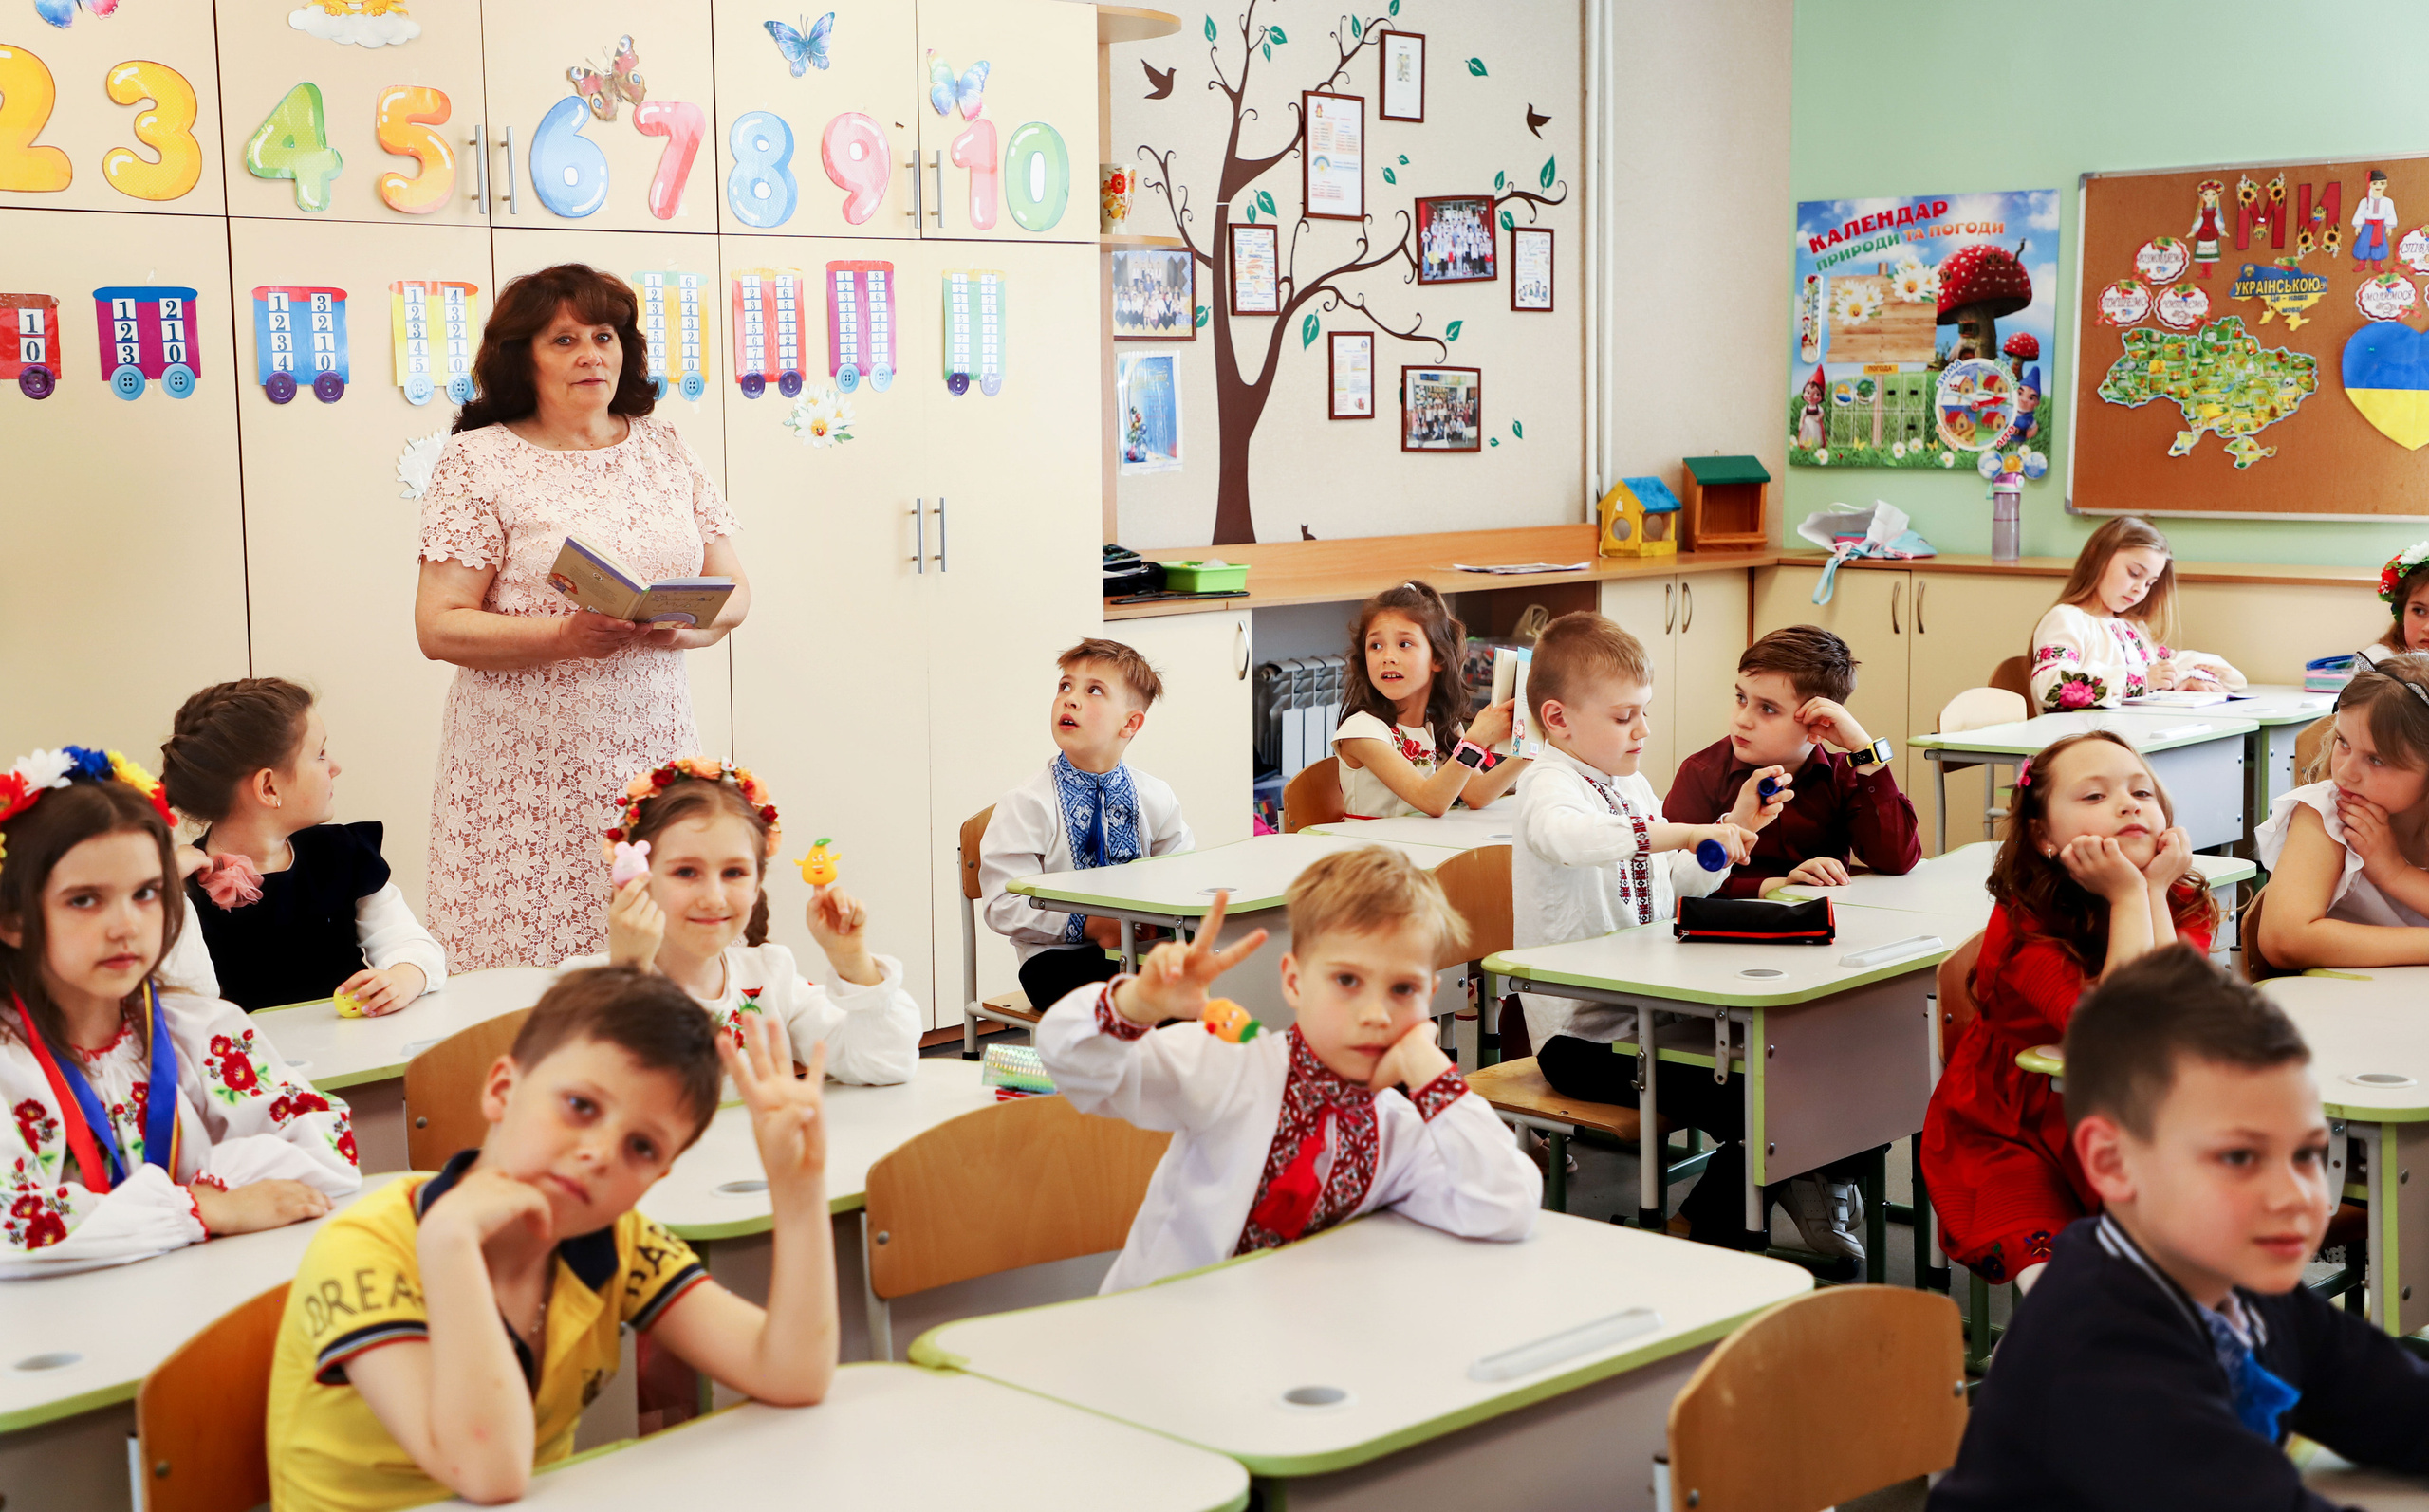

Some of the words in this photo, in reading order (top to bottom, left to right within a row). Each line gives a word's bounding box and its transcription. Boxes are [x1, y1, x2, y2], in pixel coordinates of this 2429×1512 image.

[0, 44, 72, 193] 2
[102, 60, 202, 201] 3
[247, 82, 343, 212] 4
[376, 84, 456, 214] 5
[529, 95, 609, 219] 6
[633, 101, 706, 220] 7
[727, 111, 798, 228] 8
[822, 111, 891, 225] 9
[950, 119, 1070, 232] 10
[1808, 200, 1948, 254] КАЛЕНДАР
[1815, 233, 1900, 272] ПРИРОДИ
[1902, 229, 1924, 242] ТА
[1928, 221, 2005, 238] ПОГОДИ
[651, 276, 657, 286] 1
[685, 277, 692, 287] 6
[750, 277, 754, 286] 1
[782, 277, 788, 286] 7
[2234, 276, 2321, 296] УКРАЇНСЬКОЮ
[410, 289, 419, 304] 1
[450, 289, 459, 304] 4
[651, 289, 658, 300] 2
[686, 291, 692, 302] 5
[750, 289, 755, 299] 2
[783, 289, 788, 298] 6
[844, 293, 849, 302] 3
[875, 293, 881, 302] 6
[119, 301, 131, 319] 1
[165, 300, 177, 318] 2
[274, 295, 284, 311] 1
[317, 295, 326, 311] 3
[652, 304, 658, 314] 3
[686, 304, 693, 315] 4
[750, 301, 756, 310] 3
[784, 301, 789, 309] 5
[844, 304, 849, 312] 4
[876, 304, 881, 312] 5
[411, 306, 420, 321] 2
[451, 306, 460, 321] 3
[751, 313, 757, 322] 4
[784, 313, 790, 322] 4
[845, 314, 850, 323] 5
[877, 314, 881, 323] 4
[26, 314, 38, 333] 1
[275, 315, 286, 331] 2
[318, 315, 328, 331] 2
[653, 319, 658, 328] 4
[687, 319, 694, 329] 3
[751, 324, 757, 334] 5
[785, 324, 790, 333] 3
[845, 324, 850, 333] 6
[121, 323, 133, 341] 2
[167, 323, 179, 341] 1
[413, 323, 421, 338] 3
[452, 323, 461, 338] 2
[654, 331, 659, 341] 5
[688, 332, 694, 342] 2
[277, 335, 287, 351] 3
[320, 335, 329, 351] 1
[751, 337, 758, 346] 6
[786, 337, 790, 345] 2
[845, 335, 851, 343] 7
[26, 341, 40, 361] 0
[122, 345, 135, 364] 3
[169, 344, 181, 363] 0
[414, 341, 423, 355] 4
[454, 341, 462, 355] 1
[654, 345, 659, 356] 6
[689, 347, 694, 357] 1
[753, 349, 758, 359] 7
[786, 348, 790, 357] 1
[846, 345, 851, 354] 8
[278, 355, 288, 371] 4
[321, 354, 331, 371] 0
[415, 358, 423, 372] 5
[454, 358, 463, 372] 0
[654, 360, 659, 370] 7
[688, 360, 694, 370] 0
[752, 360, 758, 371] 8
[786, 360, 791, 369] 0
[1937, 360, 1962, 386] ЗИМА
[1993, 358, 2020, 390] ВЕСНА
[1996, 425, 2016, 449] ЛІТО
